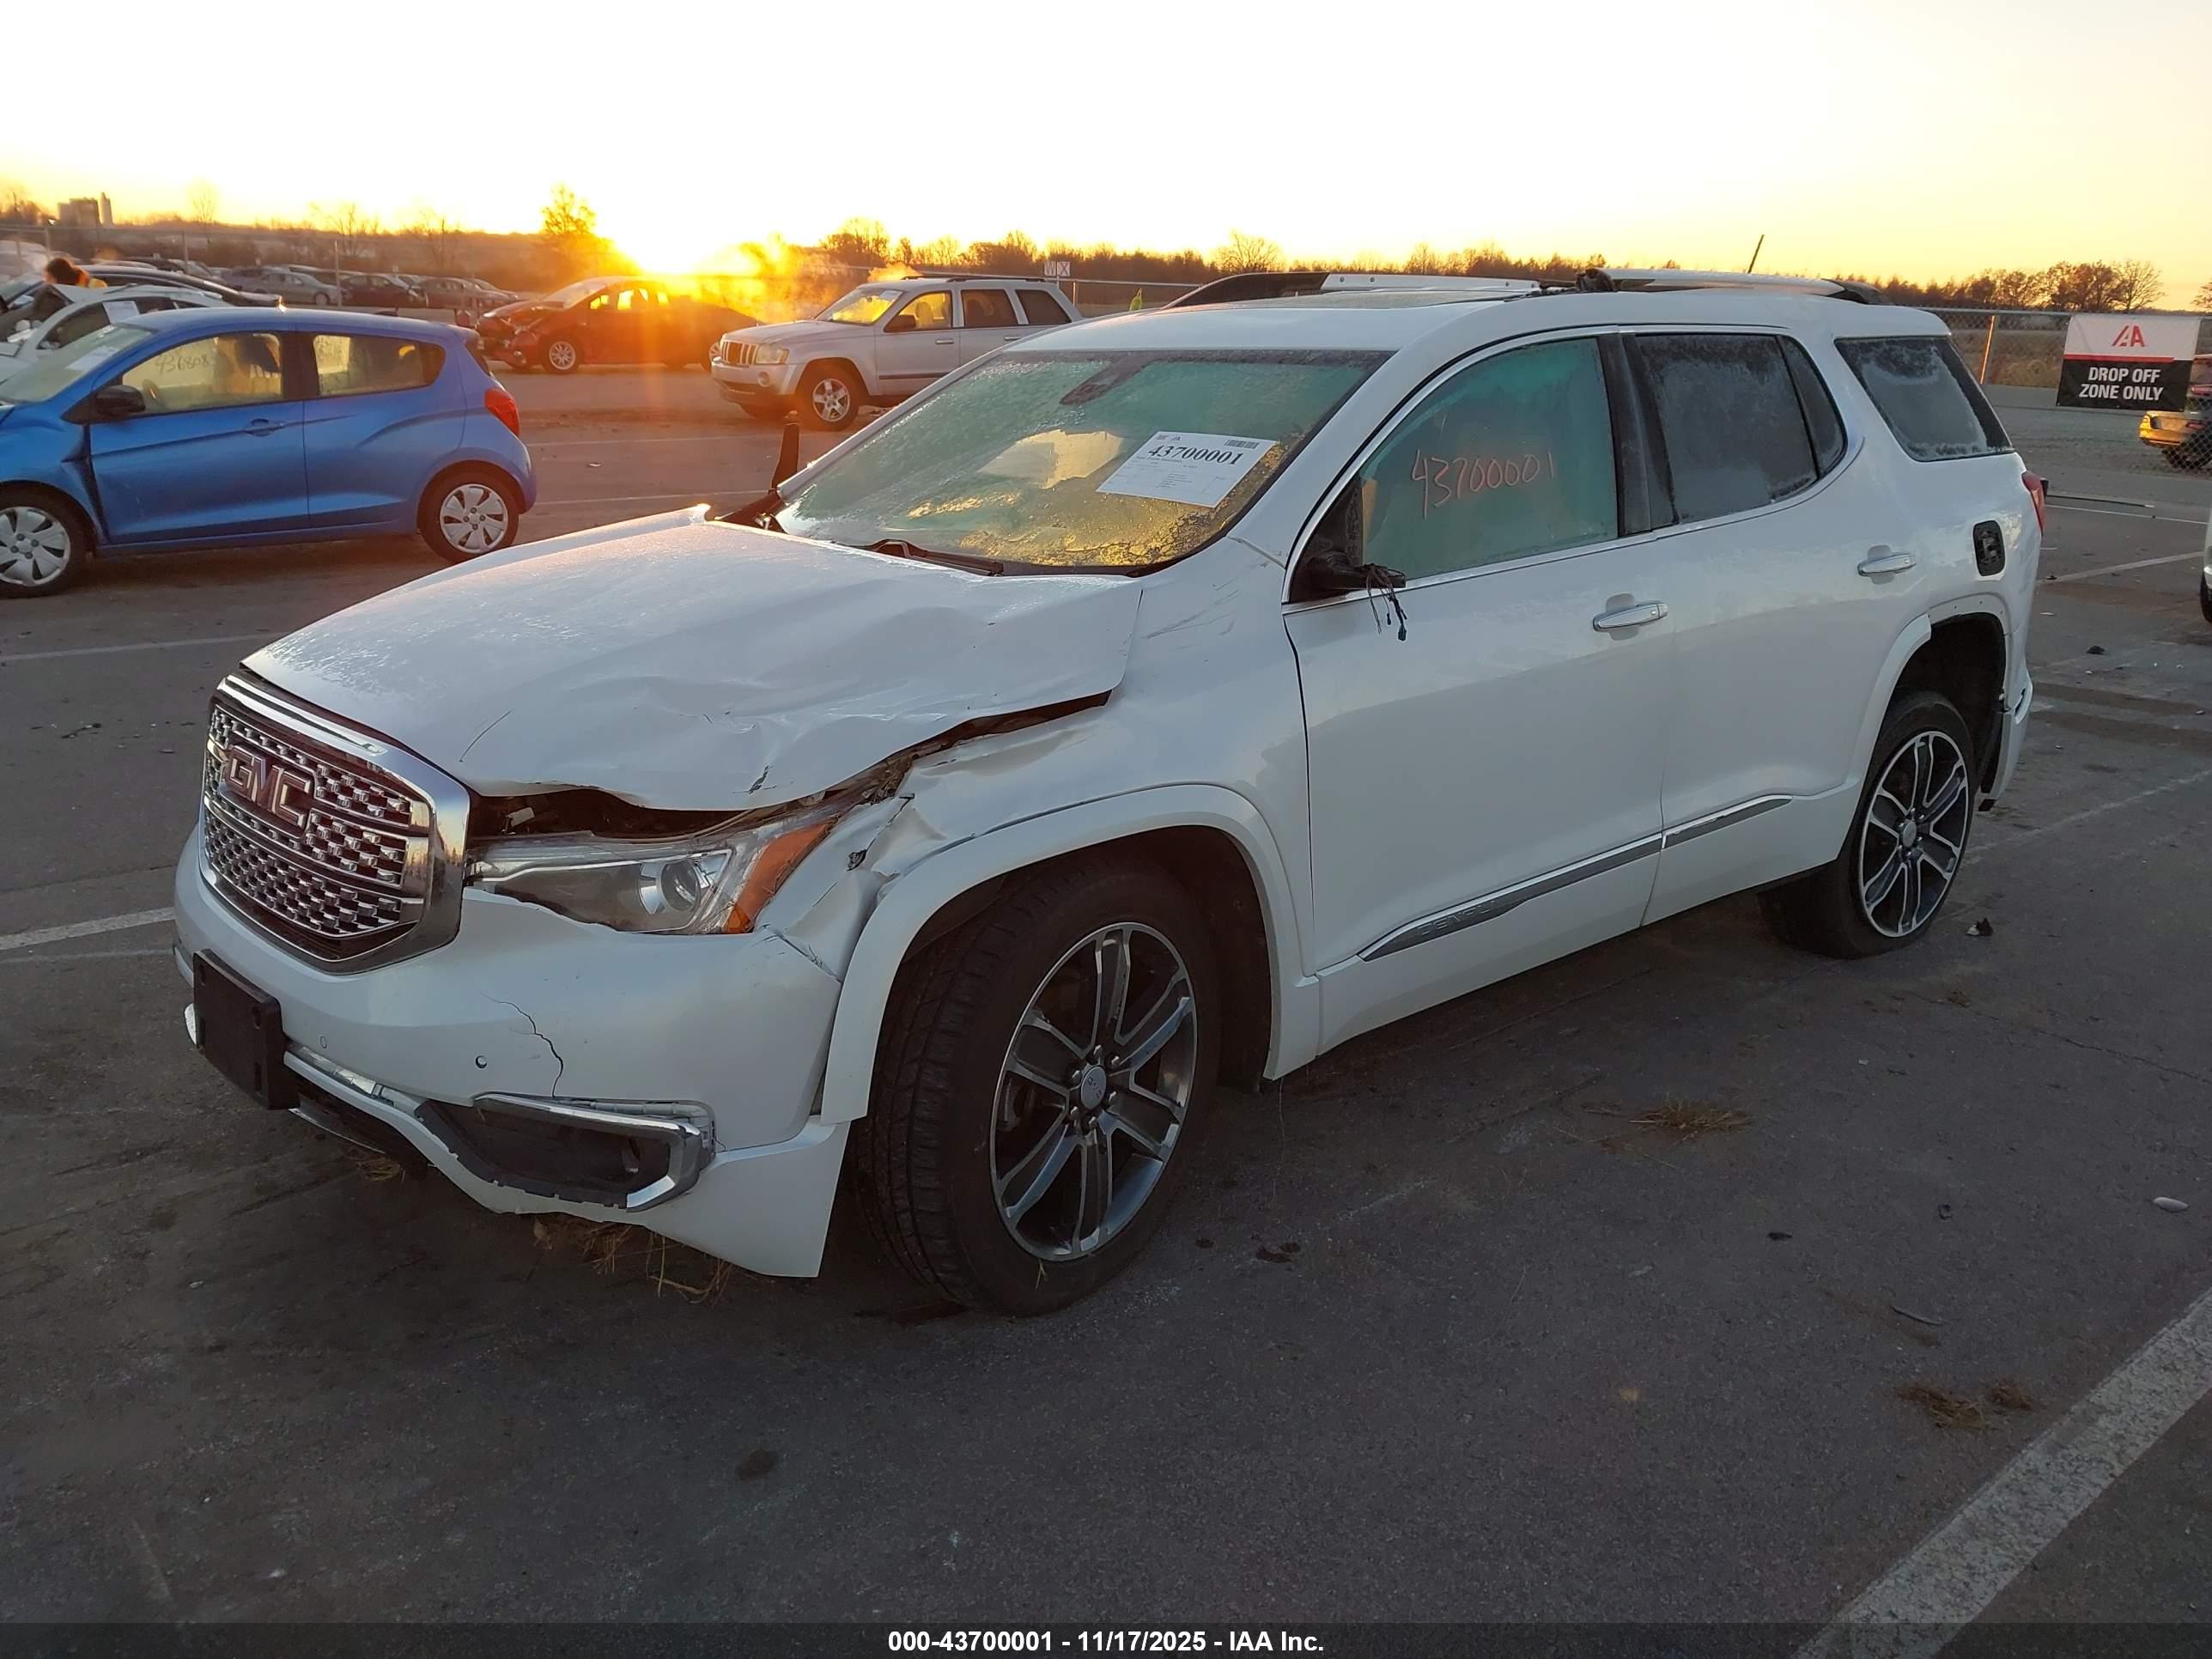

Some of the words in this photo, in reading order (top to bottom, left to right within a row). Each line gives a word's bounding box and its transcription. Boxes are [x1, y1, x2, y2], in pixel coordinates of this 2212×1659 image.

[1060, 261, 1069, 276] X
[2087, 367, 2130, 382] DROP
[2131, 368, 2161, 383] OFF
[2078, 383, 2120, 399] ZONE
[2122, 386, 2164, 401] ONLY
[1147, 445, 1244, 465] 43700001
[1411, 449, 1555, 520] 43700001
[221, 744, 311, 829] GMC
